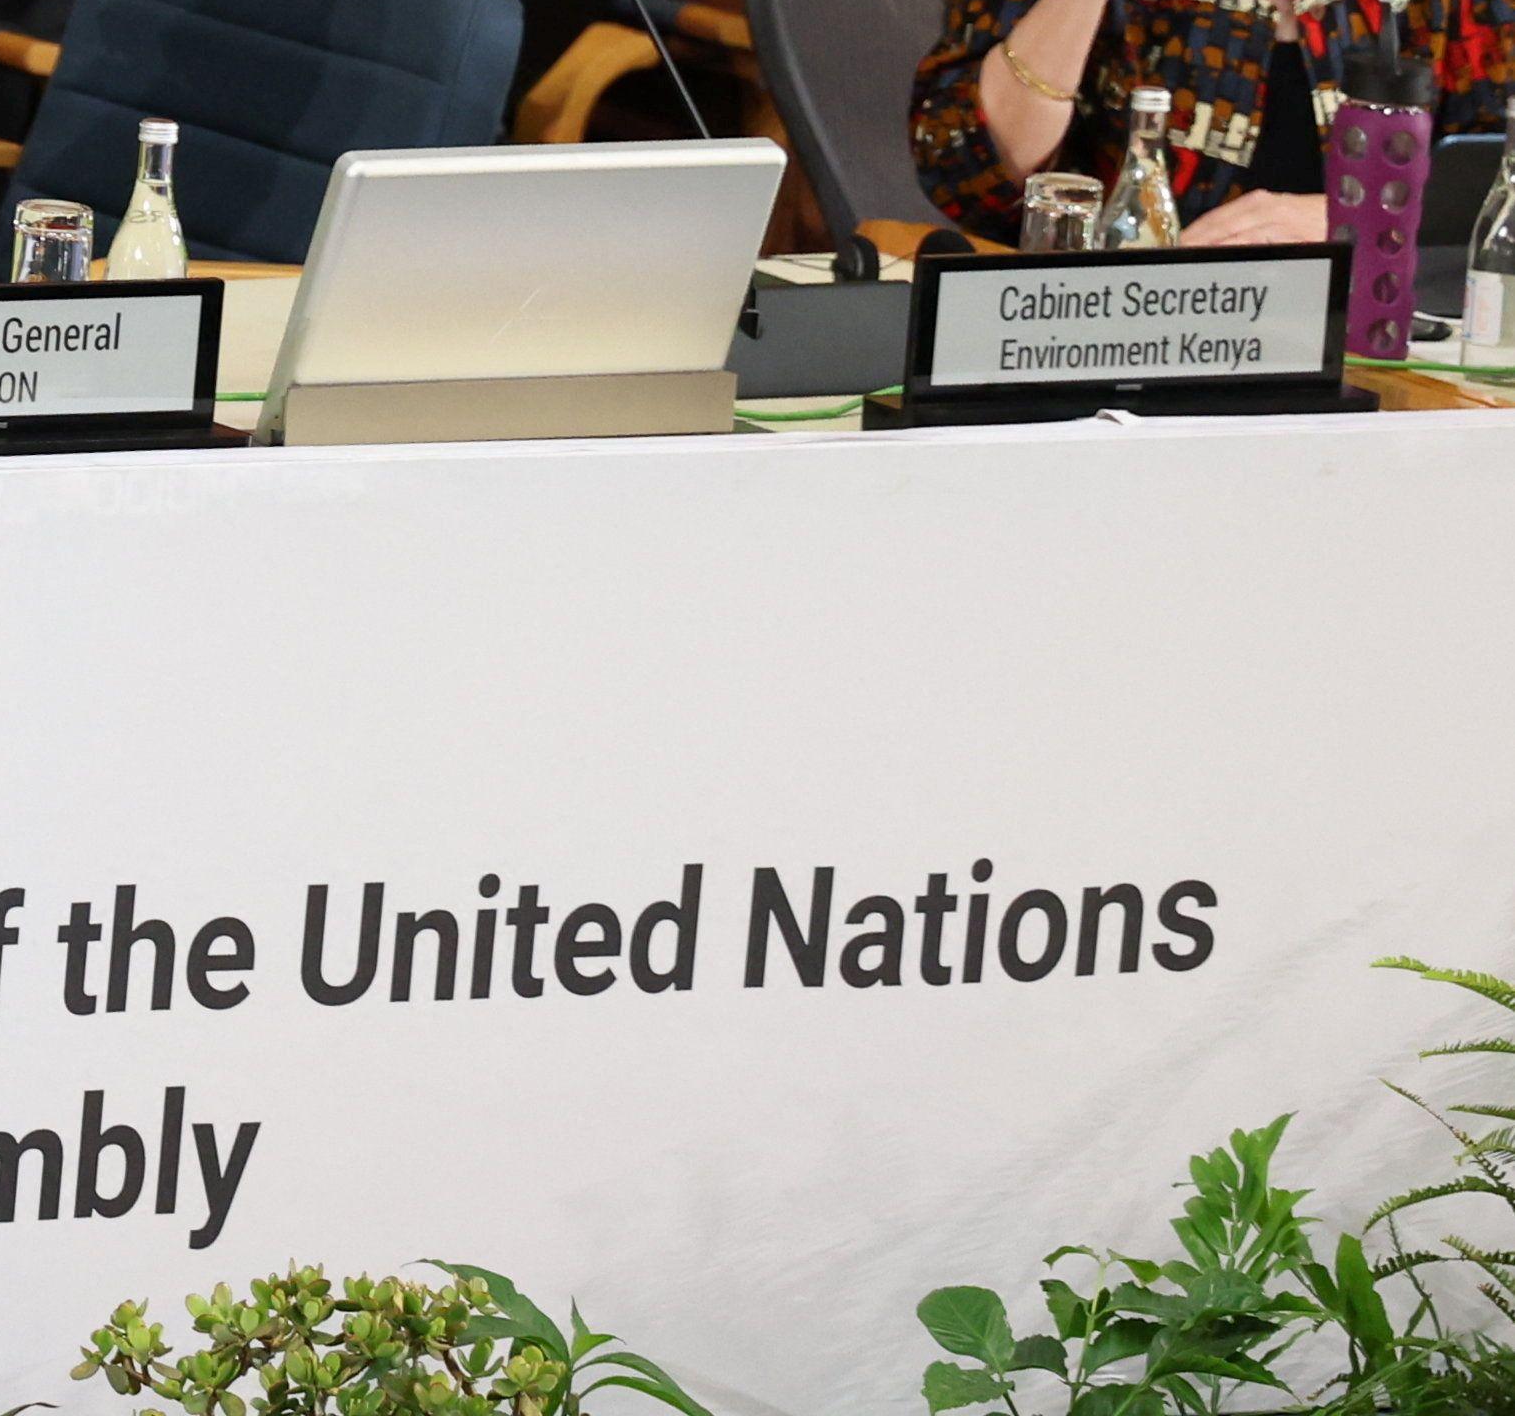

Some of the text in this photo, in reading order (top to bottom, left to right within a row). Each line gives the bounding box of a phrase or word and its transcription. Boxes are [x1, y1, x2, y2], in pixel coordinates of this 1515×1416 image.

[1000, 282, 1267, 322] Cabinet Secretary
[1000, 332, 1263, 371] Environment Kenya
[57, 884, 255, 1016] the
[301, 863, 703, 1006] United
[744, 858, 1217, 988] Nations
